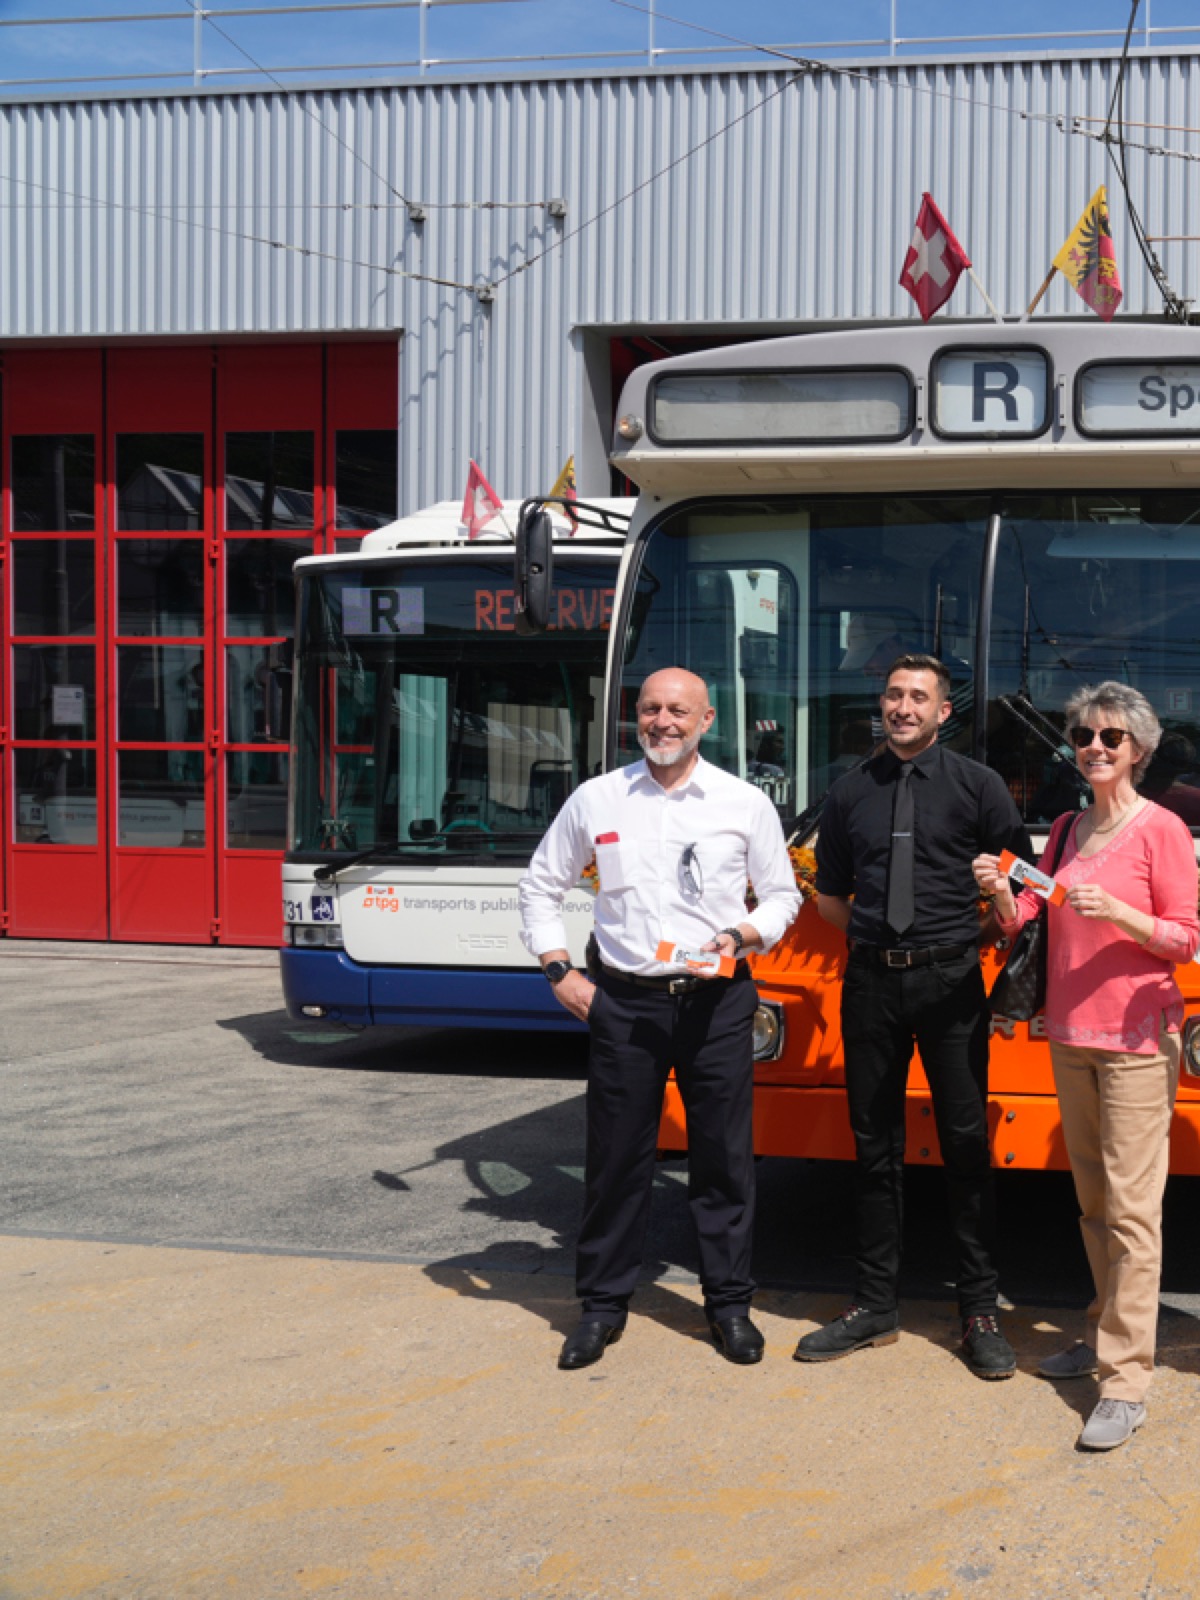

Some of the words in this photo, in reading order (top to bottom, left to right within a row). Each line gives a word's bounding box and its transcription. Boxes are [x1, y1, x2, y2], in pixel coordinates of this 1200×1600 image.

[971, 361, 1020, 423] R
[369, 588, 400, 633] R
[403, 896, 477, 913] transports
[480, 896, 521, 914] publi
